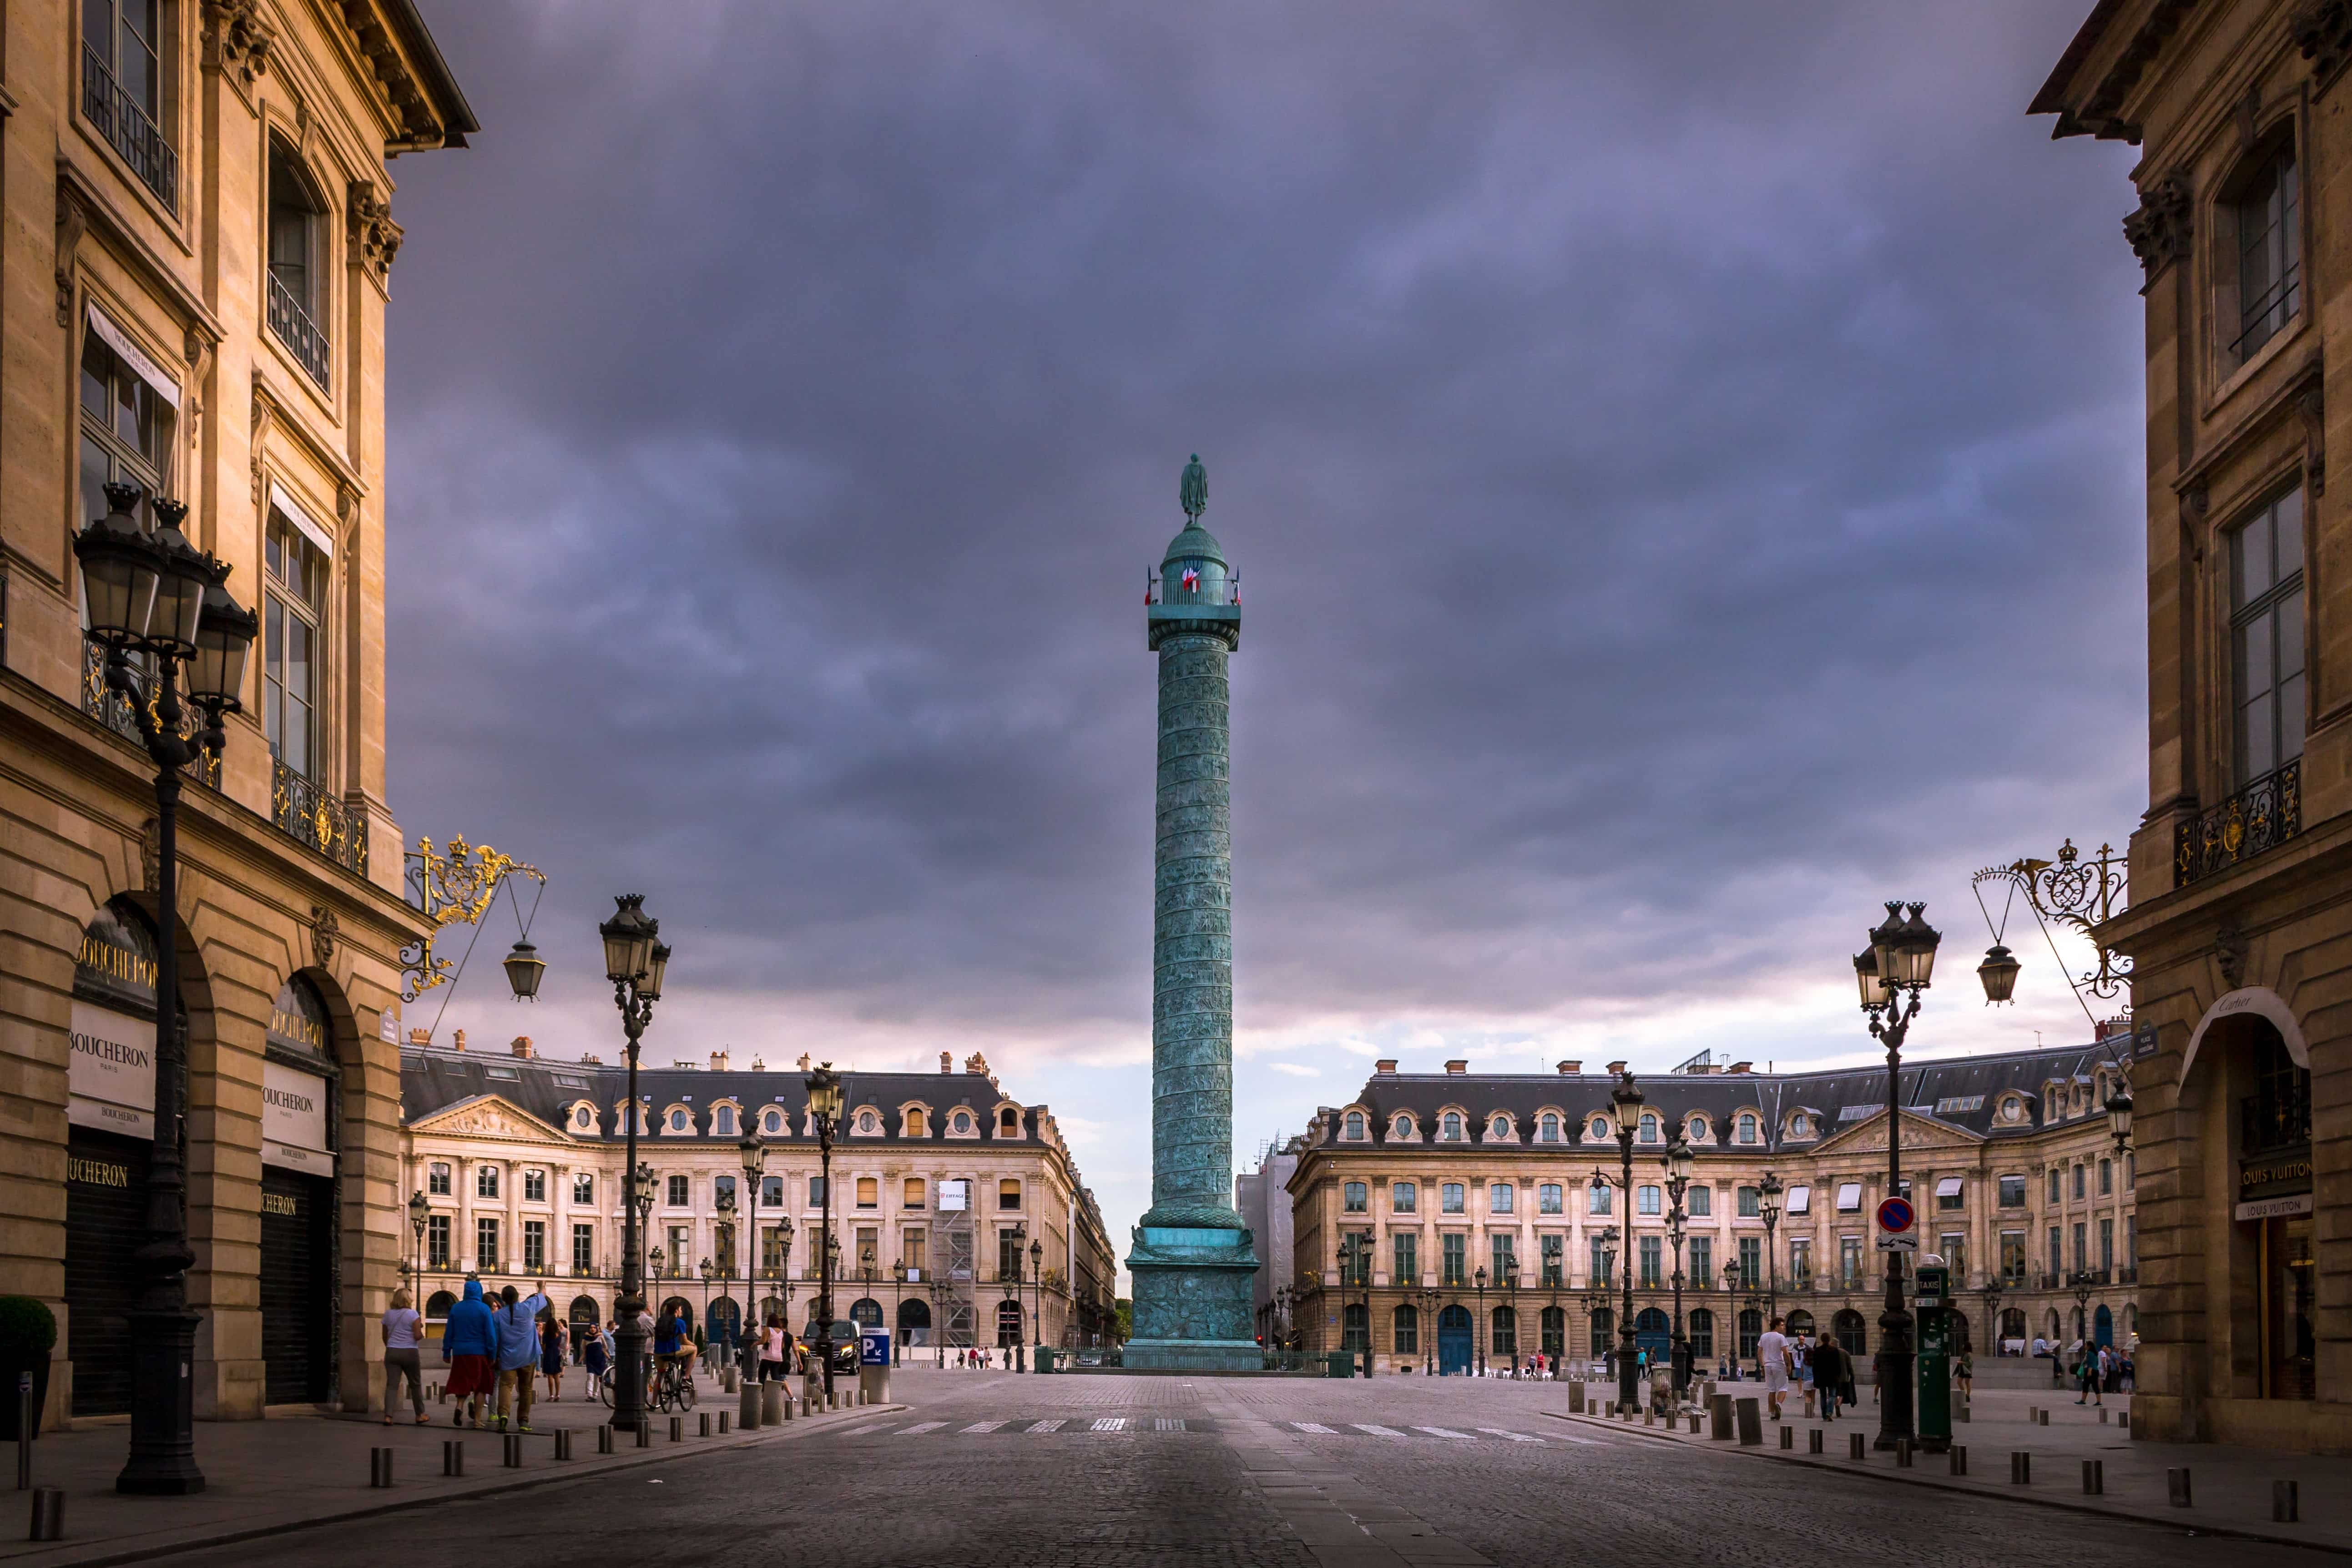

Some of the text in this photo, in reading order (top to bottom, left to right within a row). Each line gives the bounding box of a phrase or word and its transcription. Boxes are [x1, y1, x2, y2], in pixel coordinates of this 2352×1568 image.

[114, 330, 155, 377] BOUCHERON
[2219, 997, 2252, 1012] Cartier
[100, 1063, 118, 1073] PARIS
[101, 1107, 140, 1124] BOUCHERON
[2241, 1170, 2267, 1185] OUIS
[2247, 1200, 2301, 1216] LOUIS VUITTON
[1919, 1281, 1939, 1289] TAXIS
[863, 1338, 875, 1356] P
